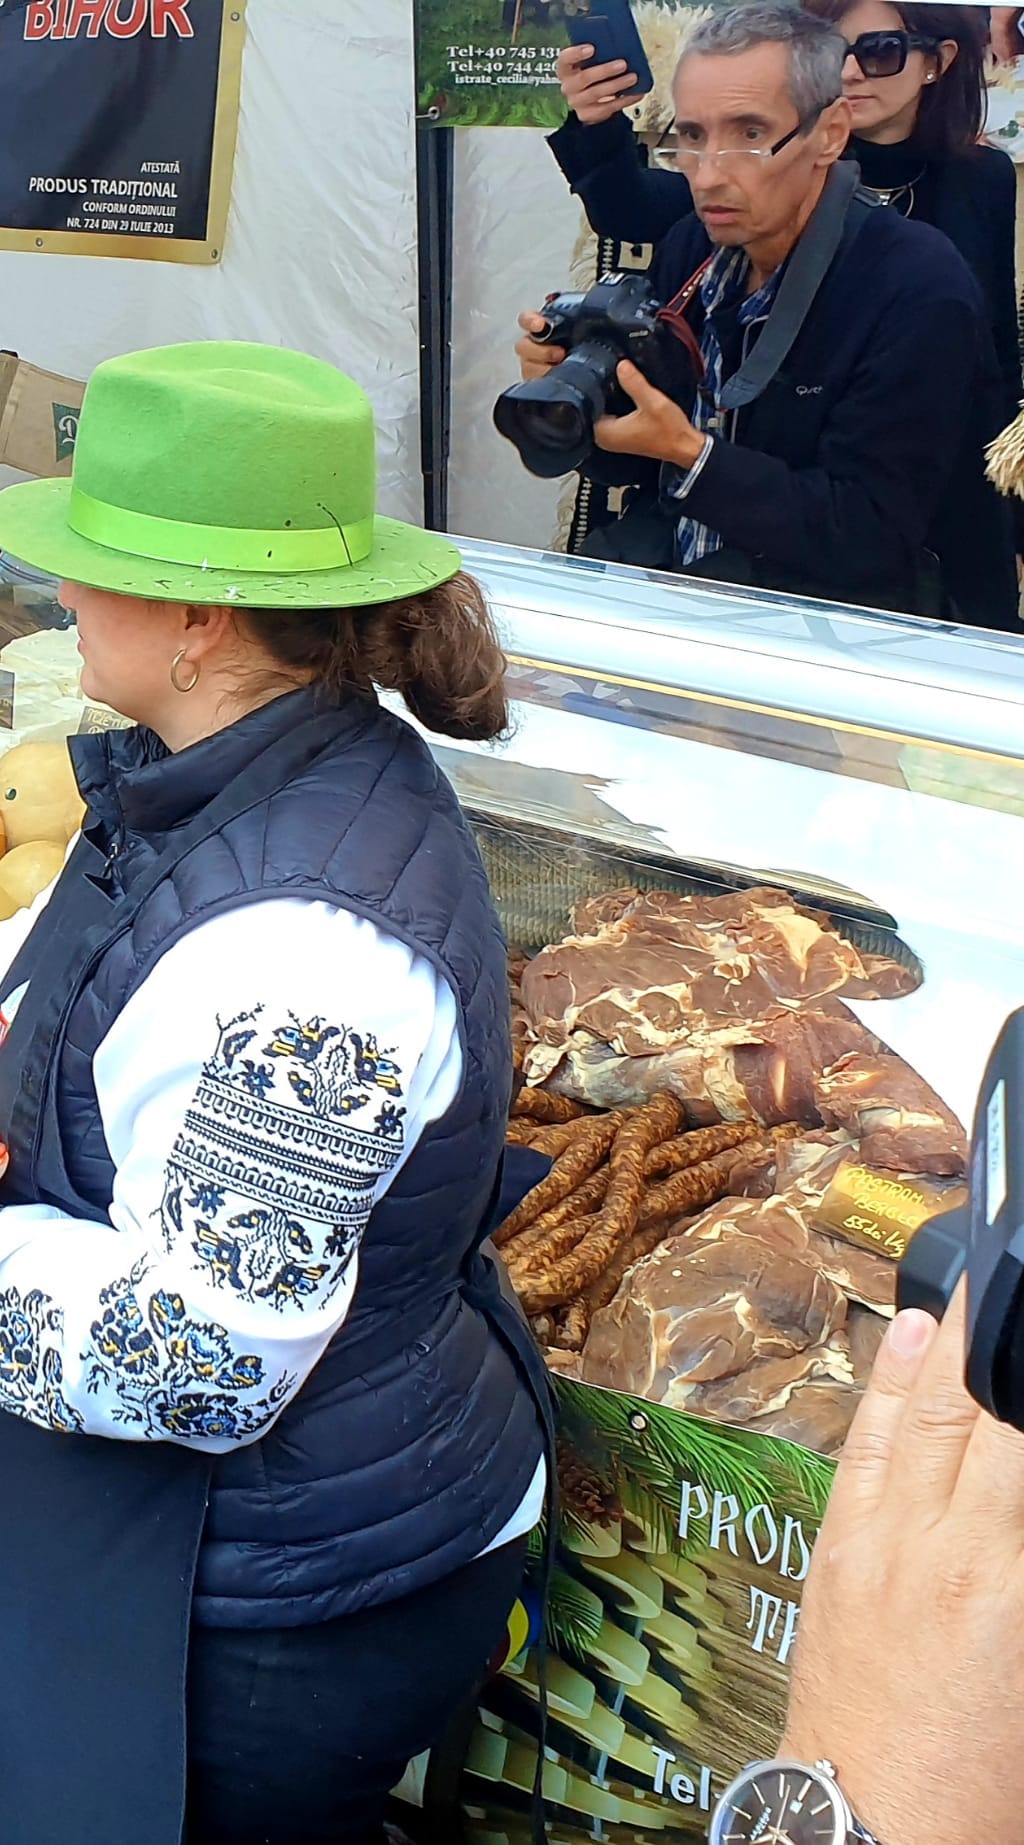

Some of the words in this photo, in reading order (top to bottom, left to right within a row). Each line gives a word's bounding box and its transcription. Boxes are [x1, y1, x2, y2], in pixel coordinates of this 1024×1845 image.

[24, 0, 194, 40] BIHOR
[509, 47, 536, 59] 745
[506, 62, 532, 73] 744
[140, 160, 180, 174] ATESTATĂ
[29, 177, 87, 194] PRODUS
[82, 201, 127, 214] CONFORM
[128, 204, 176, 217] ORDINULUI
[66, 217, 81, 229] NR.
[83, 218, 99, 229] 724
[101, 220, 118, 231] DIN
[130, 222, 152, 232] IULIE
[154, 222, 174, 234] 2013
[678, 1479, 821, 1581] PROD
